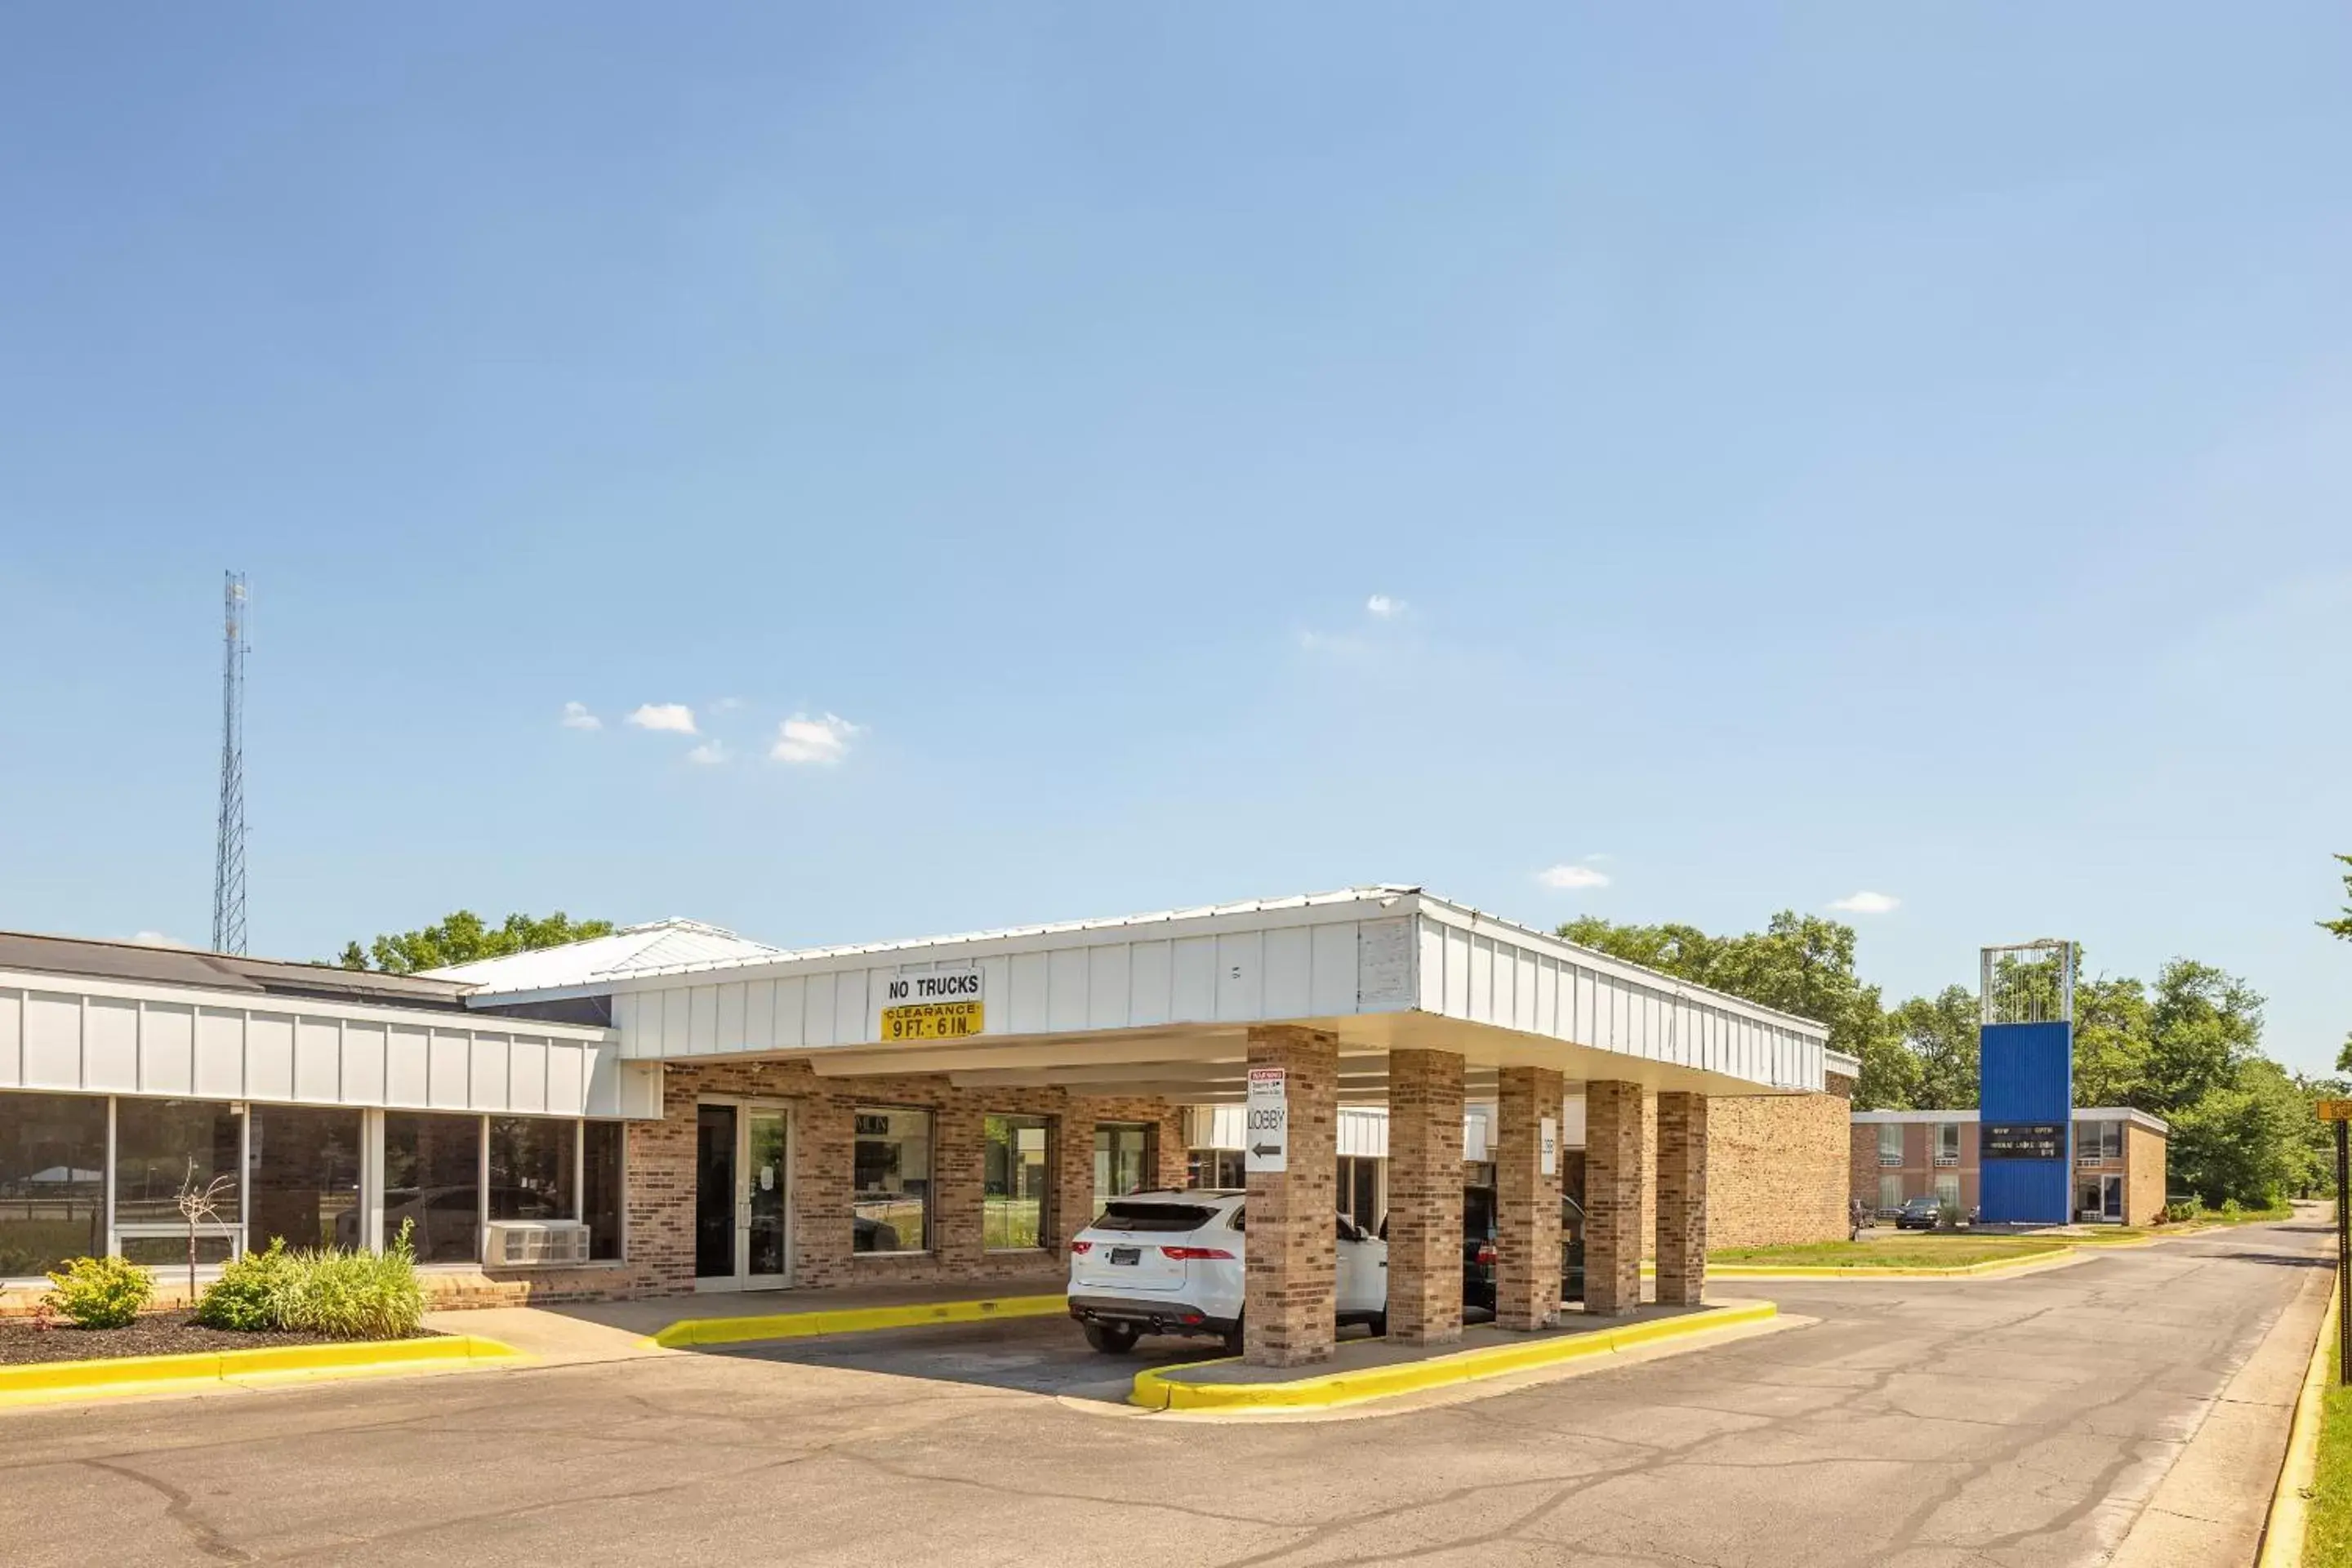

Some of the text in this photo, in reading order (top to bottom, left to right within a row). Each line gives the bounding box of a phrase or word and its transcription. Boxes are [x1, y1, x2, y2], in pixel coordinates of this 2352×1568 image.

[889, 975, 978, 999] NO TRUCKS
[886, 1004, 976, 1019] CLEARANCE
[1248, 1109, 1285, 1129] LOBBY
